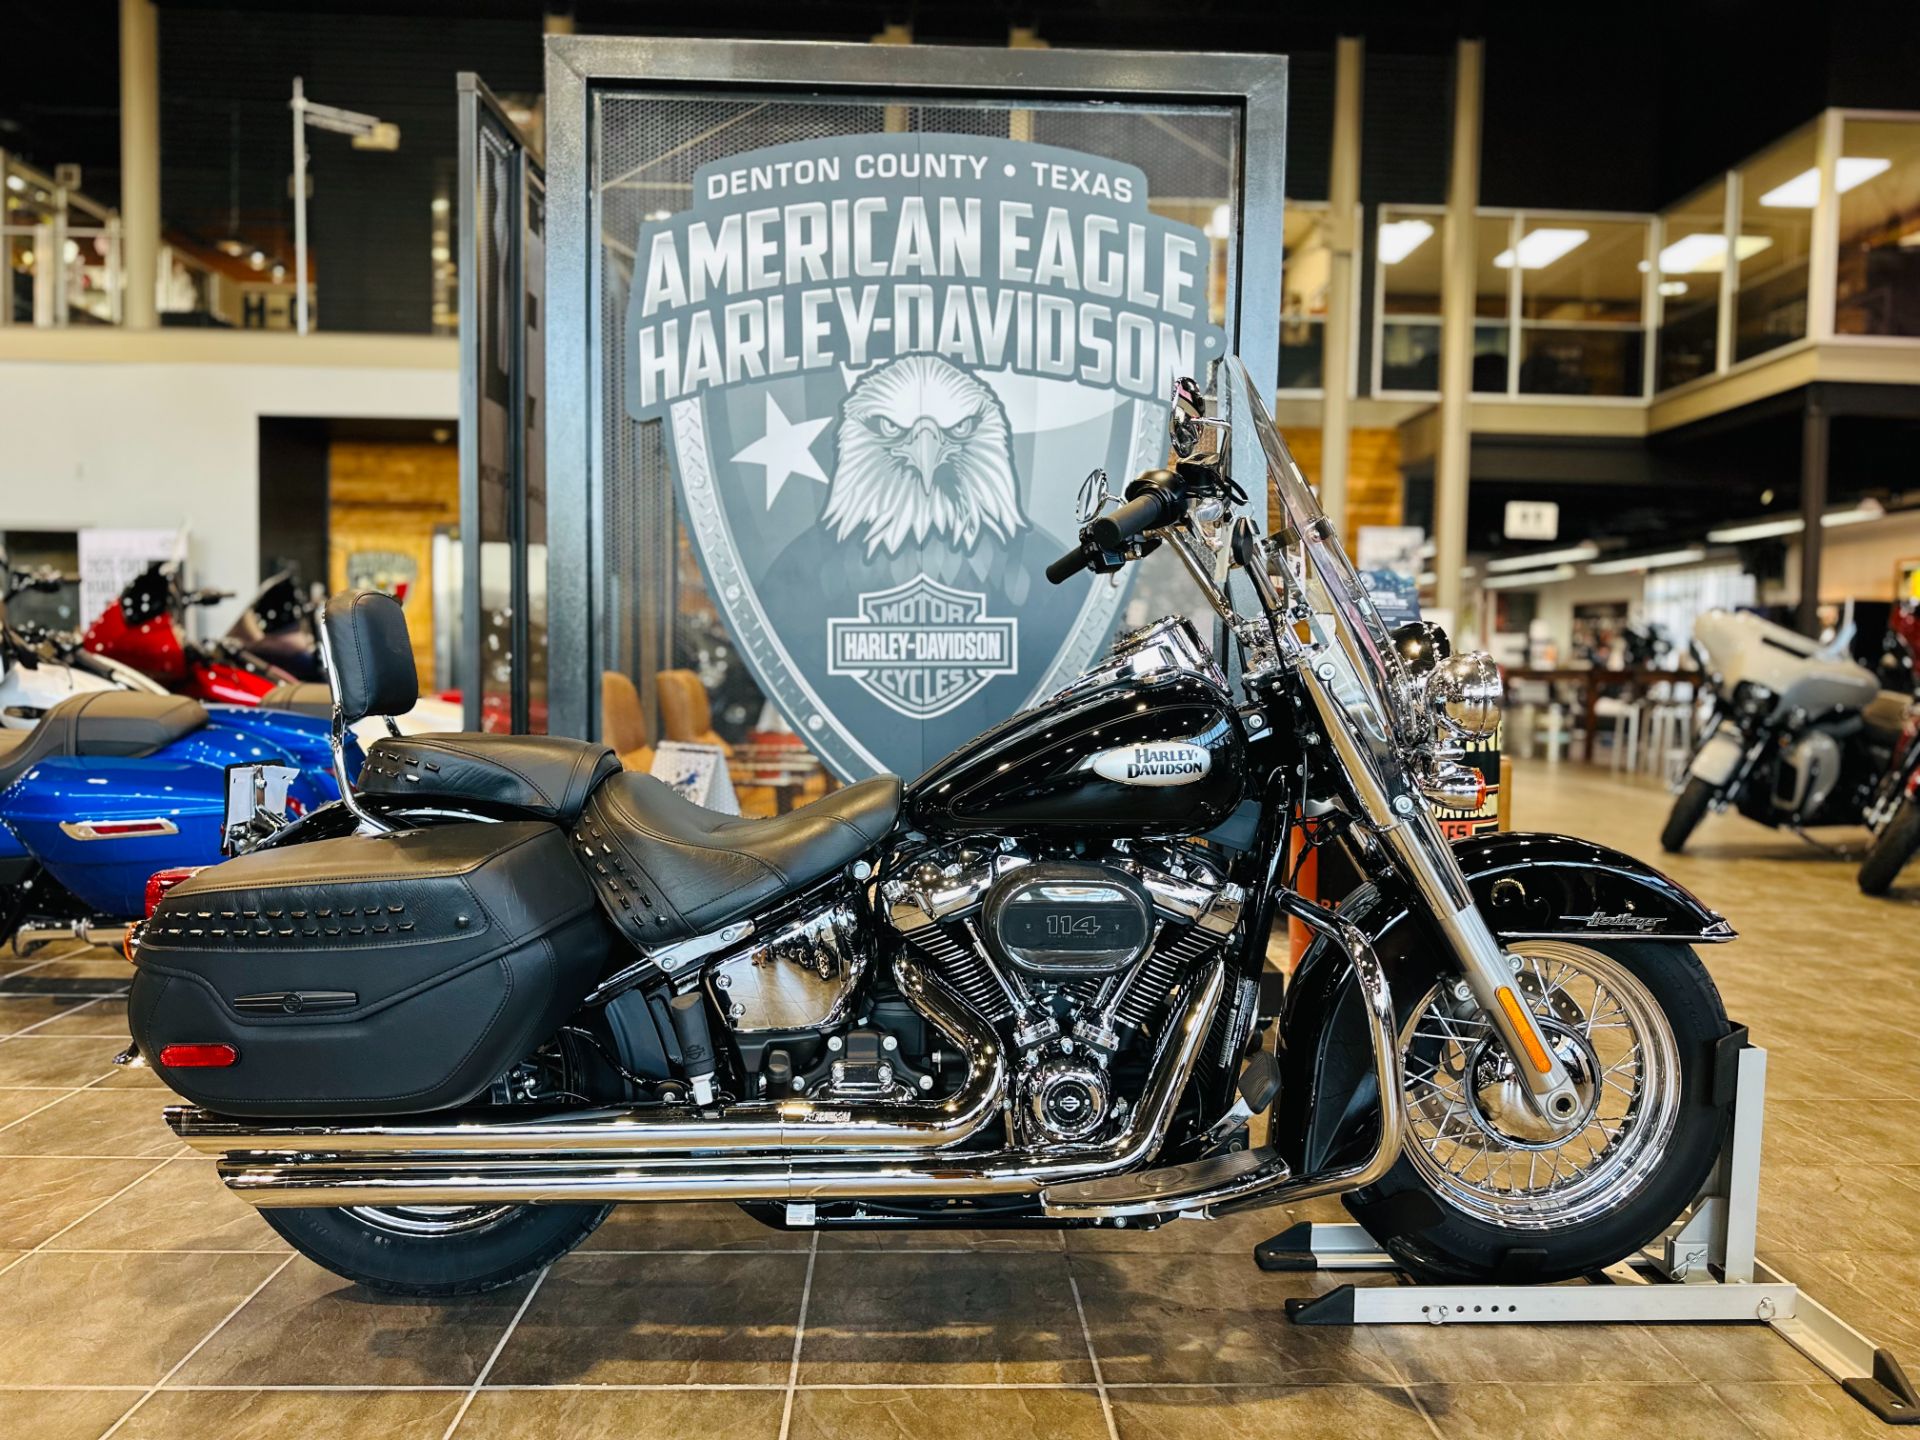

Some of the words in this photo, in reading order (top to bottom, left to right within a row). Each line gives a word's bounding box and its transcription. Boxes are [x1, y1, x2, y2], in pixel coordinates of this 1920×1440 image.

[707, 156, 840, 200] DENTON
[855, 153, 988, 180] COUNTY
[1031, 161, 1132, 203] TEXAS
[641, 195, 982, 318] AMERICAN
[999, 200, 1198, 319] EAGLE
[638, 284, 1195, 408] HARLEY-DAVIDSON
[881, 593, 964, 624] MOTOR
[844, 631, 1001, 661] HARLEY-DAVIDSON
[881, 669, 965, 706] CYCLES
[1127, 761, 1203, 779] DAVIDSON
[1046, 914, 1101, 935] 114
